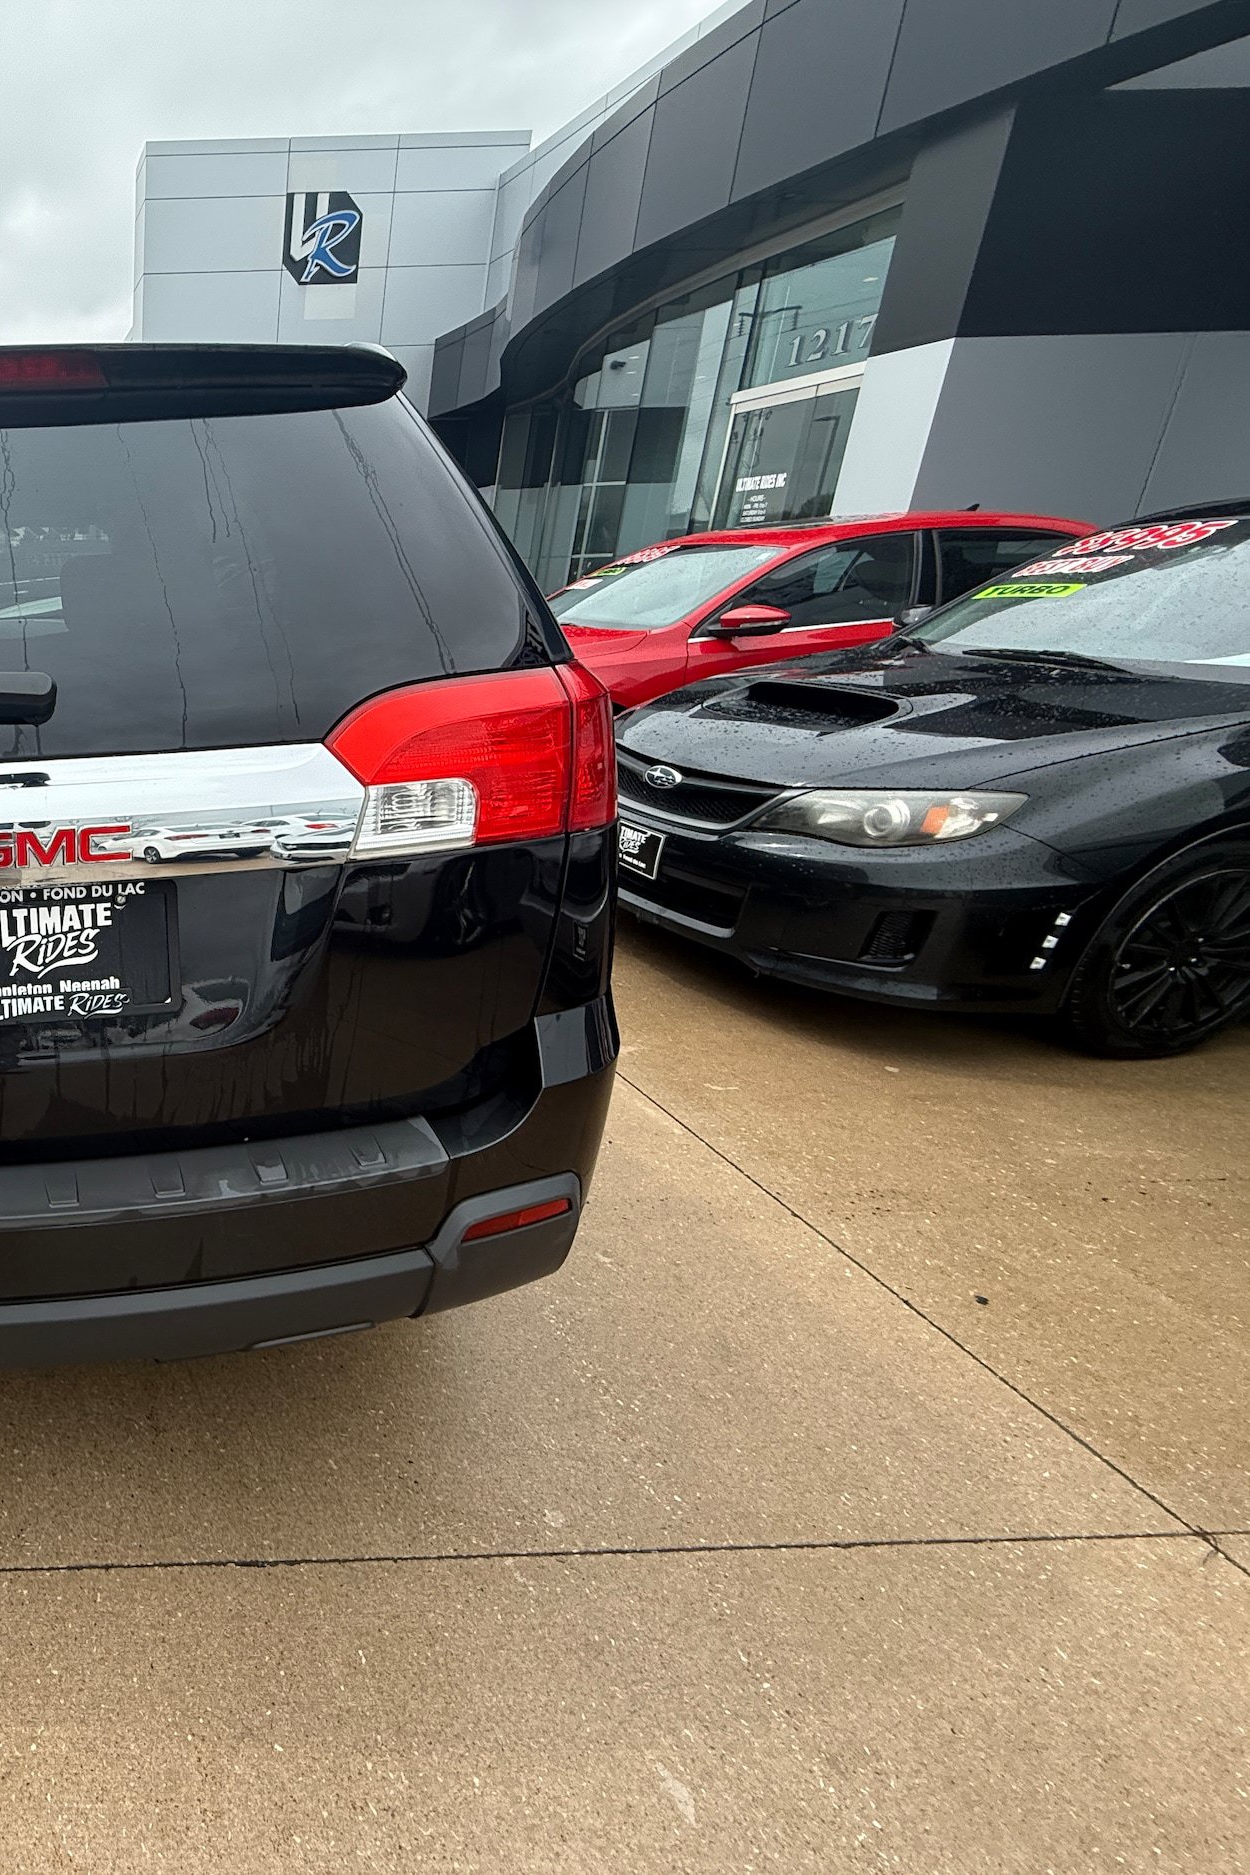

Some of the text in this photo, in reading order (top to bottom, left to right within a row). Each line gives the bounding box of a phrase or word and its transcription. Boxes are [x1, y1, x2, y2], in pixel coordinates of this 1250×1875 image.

[785, 313, 879, 367] 1217
[1063, 555, 1135, 573] BUY
[984, 585, 1070, 597] TURBO
[620, 826, 647, 844] TIMATE
[43, 886, 87, 901] FOND
[91, 884, 113, 898] DU
[118, 881, 146, 897] LAC
[59, 976, 120, 993] Neenah
